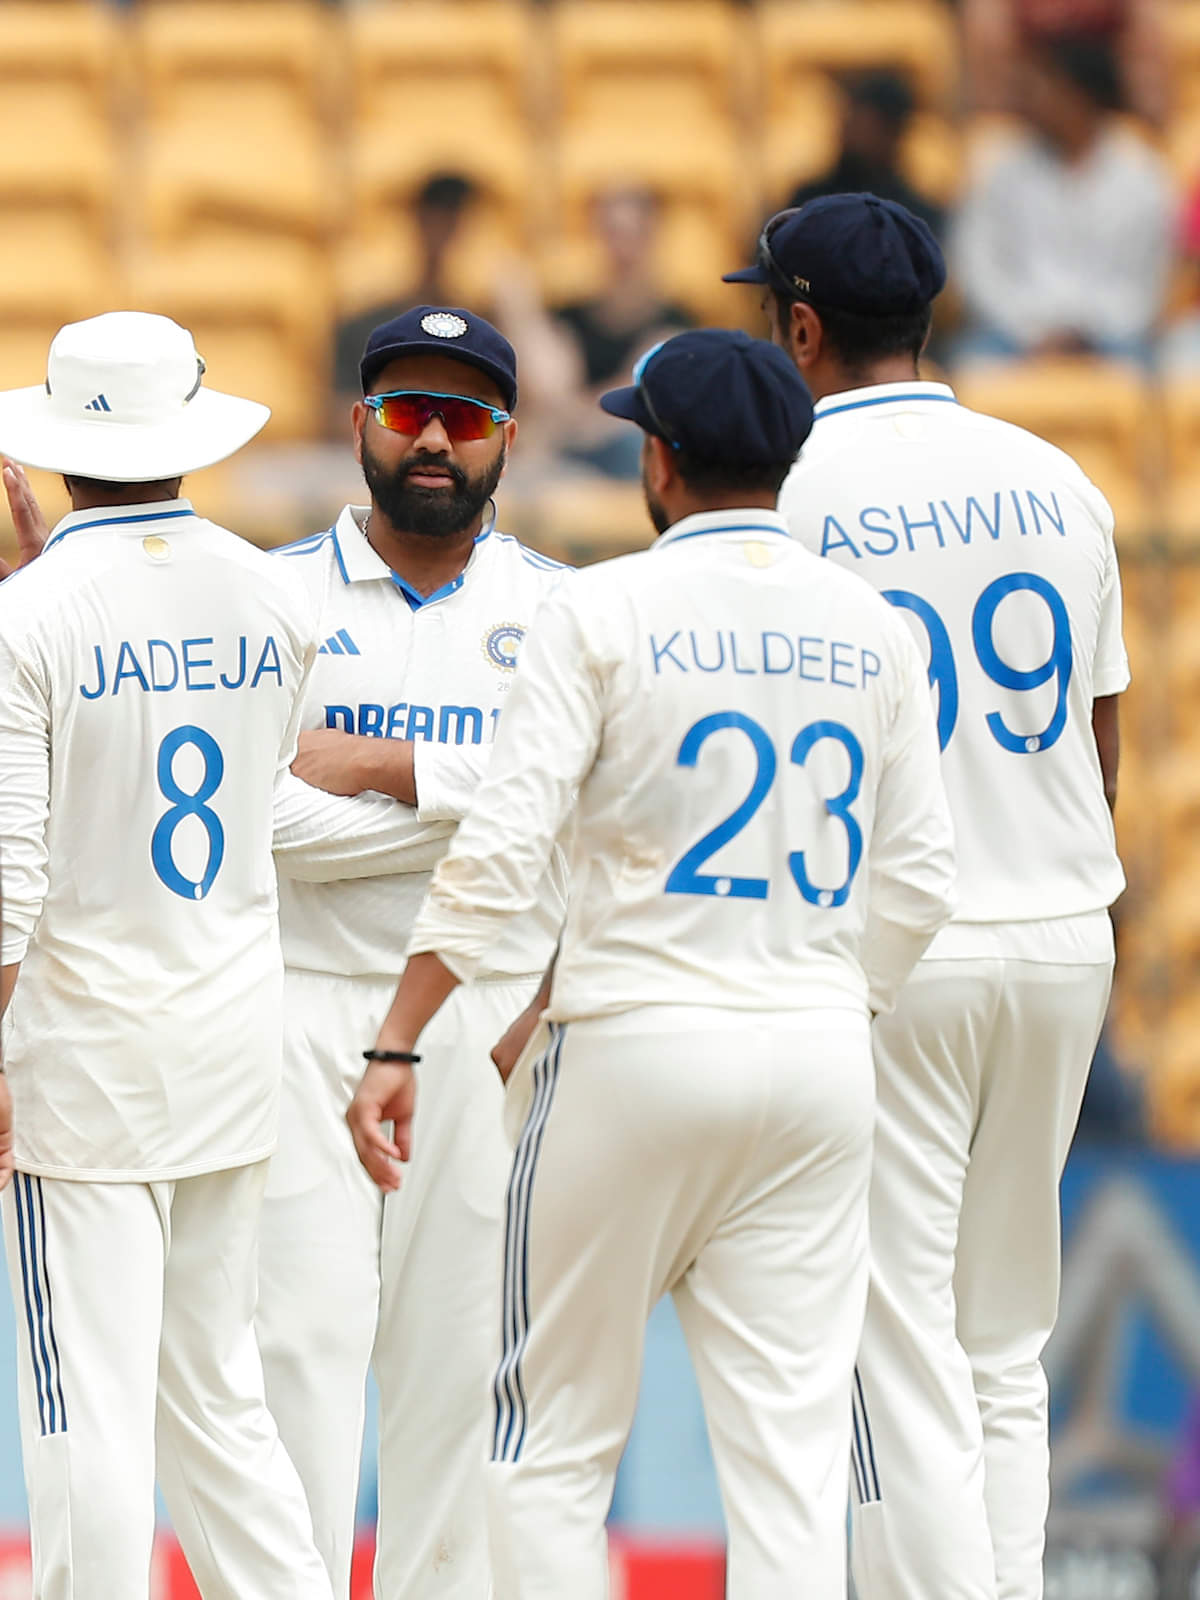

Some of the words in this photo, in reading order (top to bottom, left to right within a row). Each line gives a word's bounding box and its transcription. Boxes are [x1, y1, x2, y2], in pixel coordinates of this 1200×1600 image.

[820, 489, 1067, 559] ASHWIN
[79, 634, 284, 701] JADEJA
[649, 630, 882, 690] KULDEEP
[150, 723, 226, 902] 8
[663, 709, 865, 909] 23
